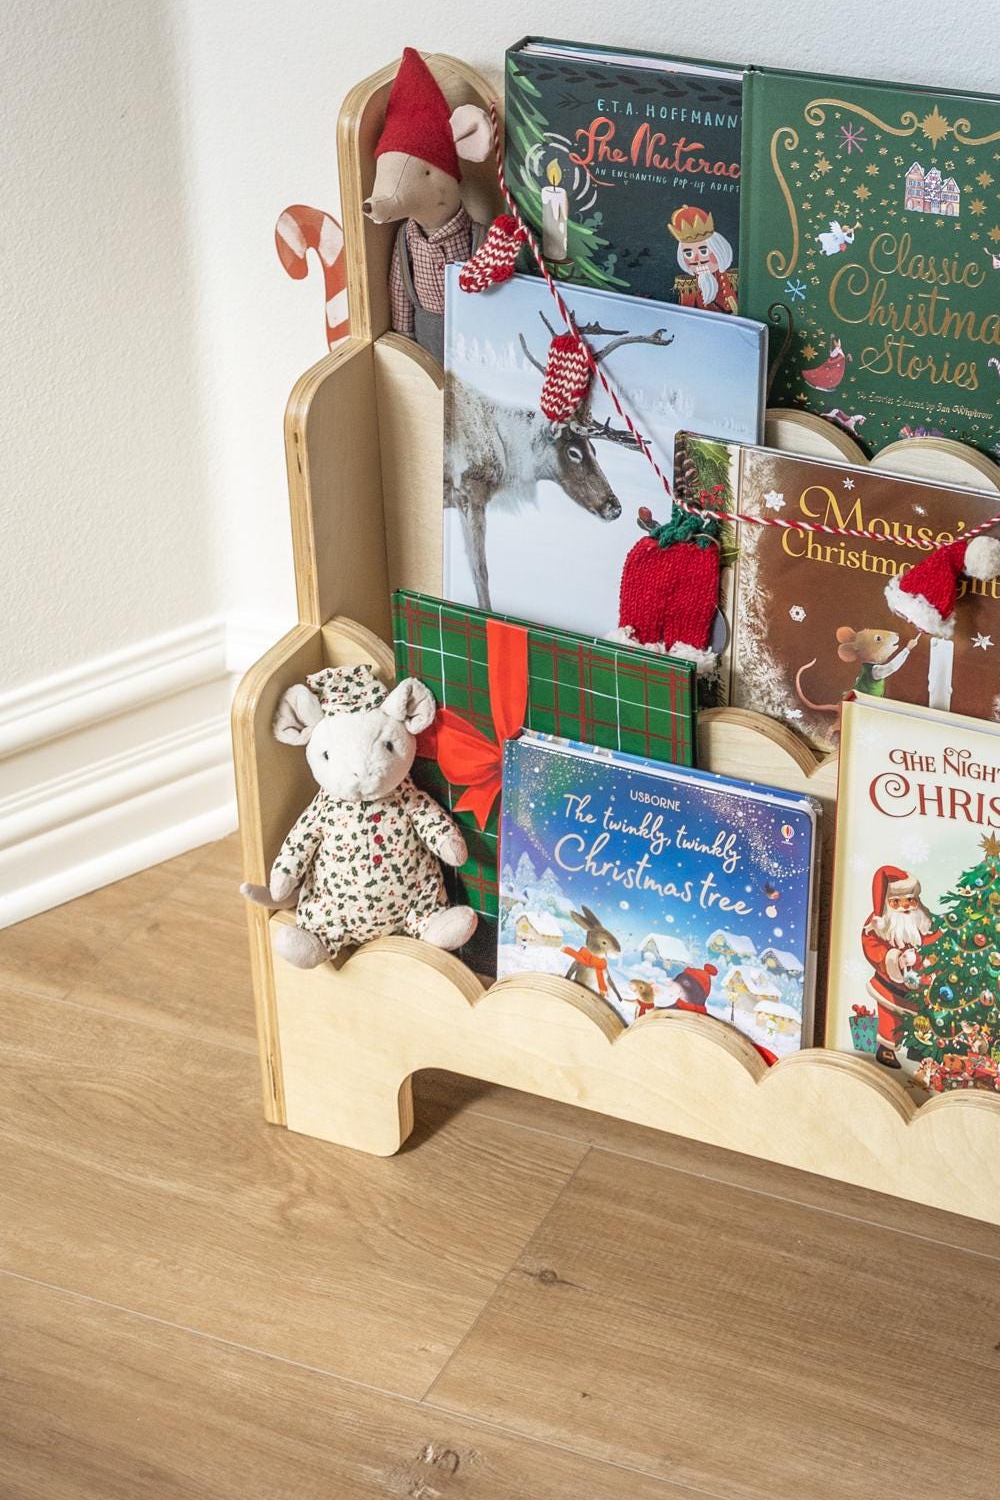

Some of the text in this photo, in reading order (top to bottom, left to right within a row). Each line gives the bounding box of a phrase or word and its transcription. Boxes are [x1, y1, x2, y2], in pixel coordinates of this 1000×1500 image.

[597, 99, 639, 116] E.T.A.
[568, 116, 629, 187] The
[595, 167, 607, 176] AN
[611, 169, 668, 185] ENCHANTING
[869, 232, 986, 288] Classic
[858, 333, 979, 391] Stories
[799, 485, 972, 552] Mouse'
[888, 749, 937, 773] THE
[629, 790, 682, 812] USBORNE
[563, 793, 741, 874] The twinkly, twinkly
[554, 832, 753, 915] Christmas tree
